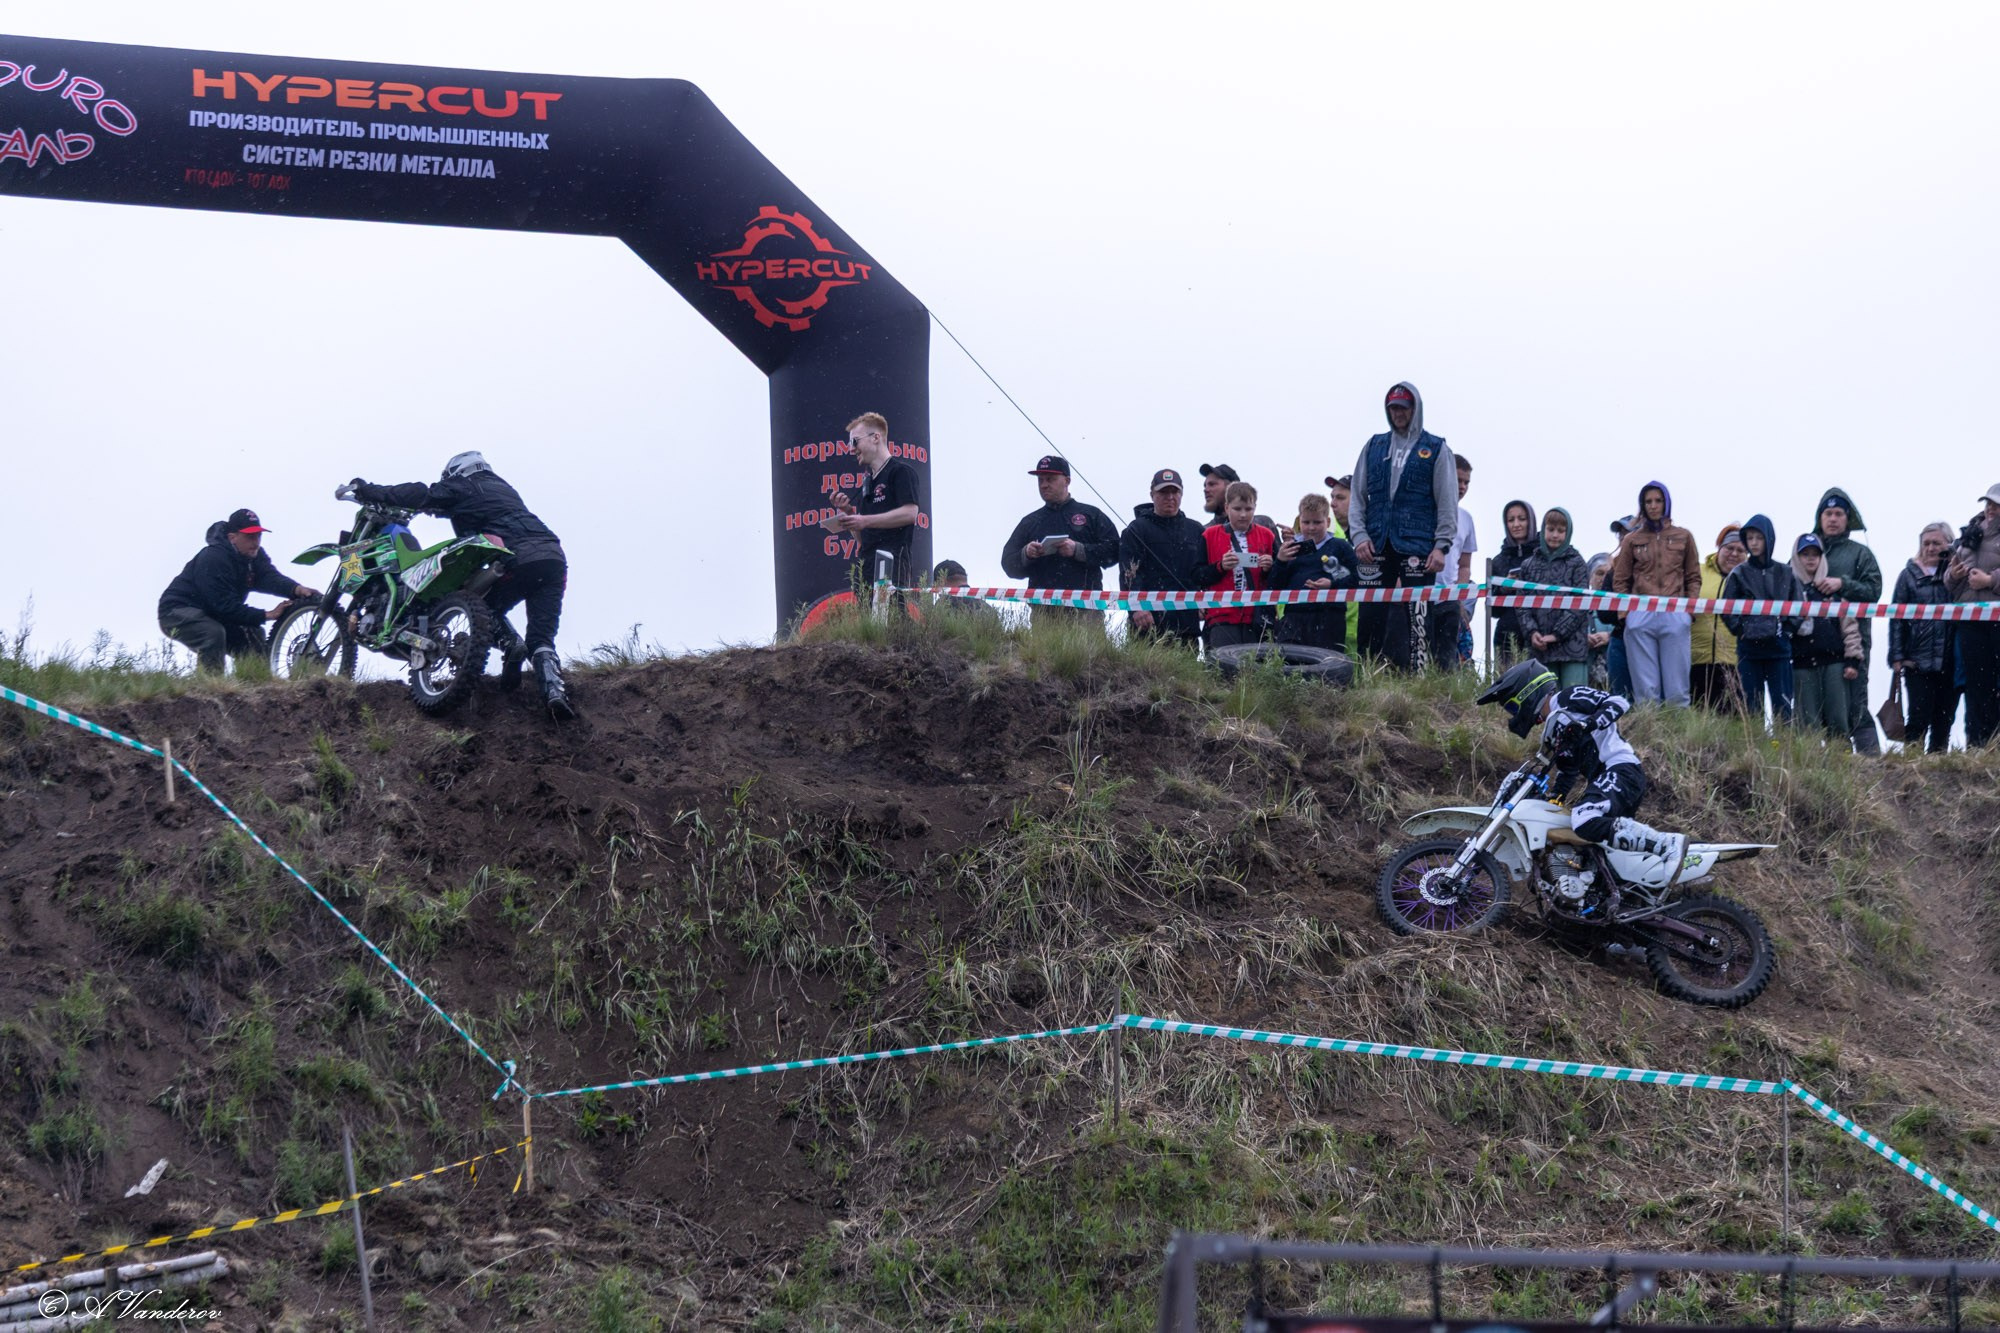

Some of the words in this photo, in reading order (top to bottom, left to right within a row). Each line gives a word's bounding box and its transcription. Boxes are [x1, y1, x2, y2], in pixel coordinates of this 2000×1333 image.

[192, 69, 563, 121] HYPERCUT
[189, 110, 366, 139] ПРОИЗВОДИТЕЛЬ
[369, 122, 550, 150] ПРОМЫШЛЕННЫХ
[242, 143, 326, 168] СИСТЕМ
[328, 149, 397, 173] РЕЗКИ
[400, 154, 496, 179] МЕТАЛЛА
[694, 258, 872, 281] HYPERCUT
[784, 440, 928, 465] нормьно
